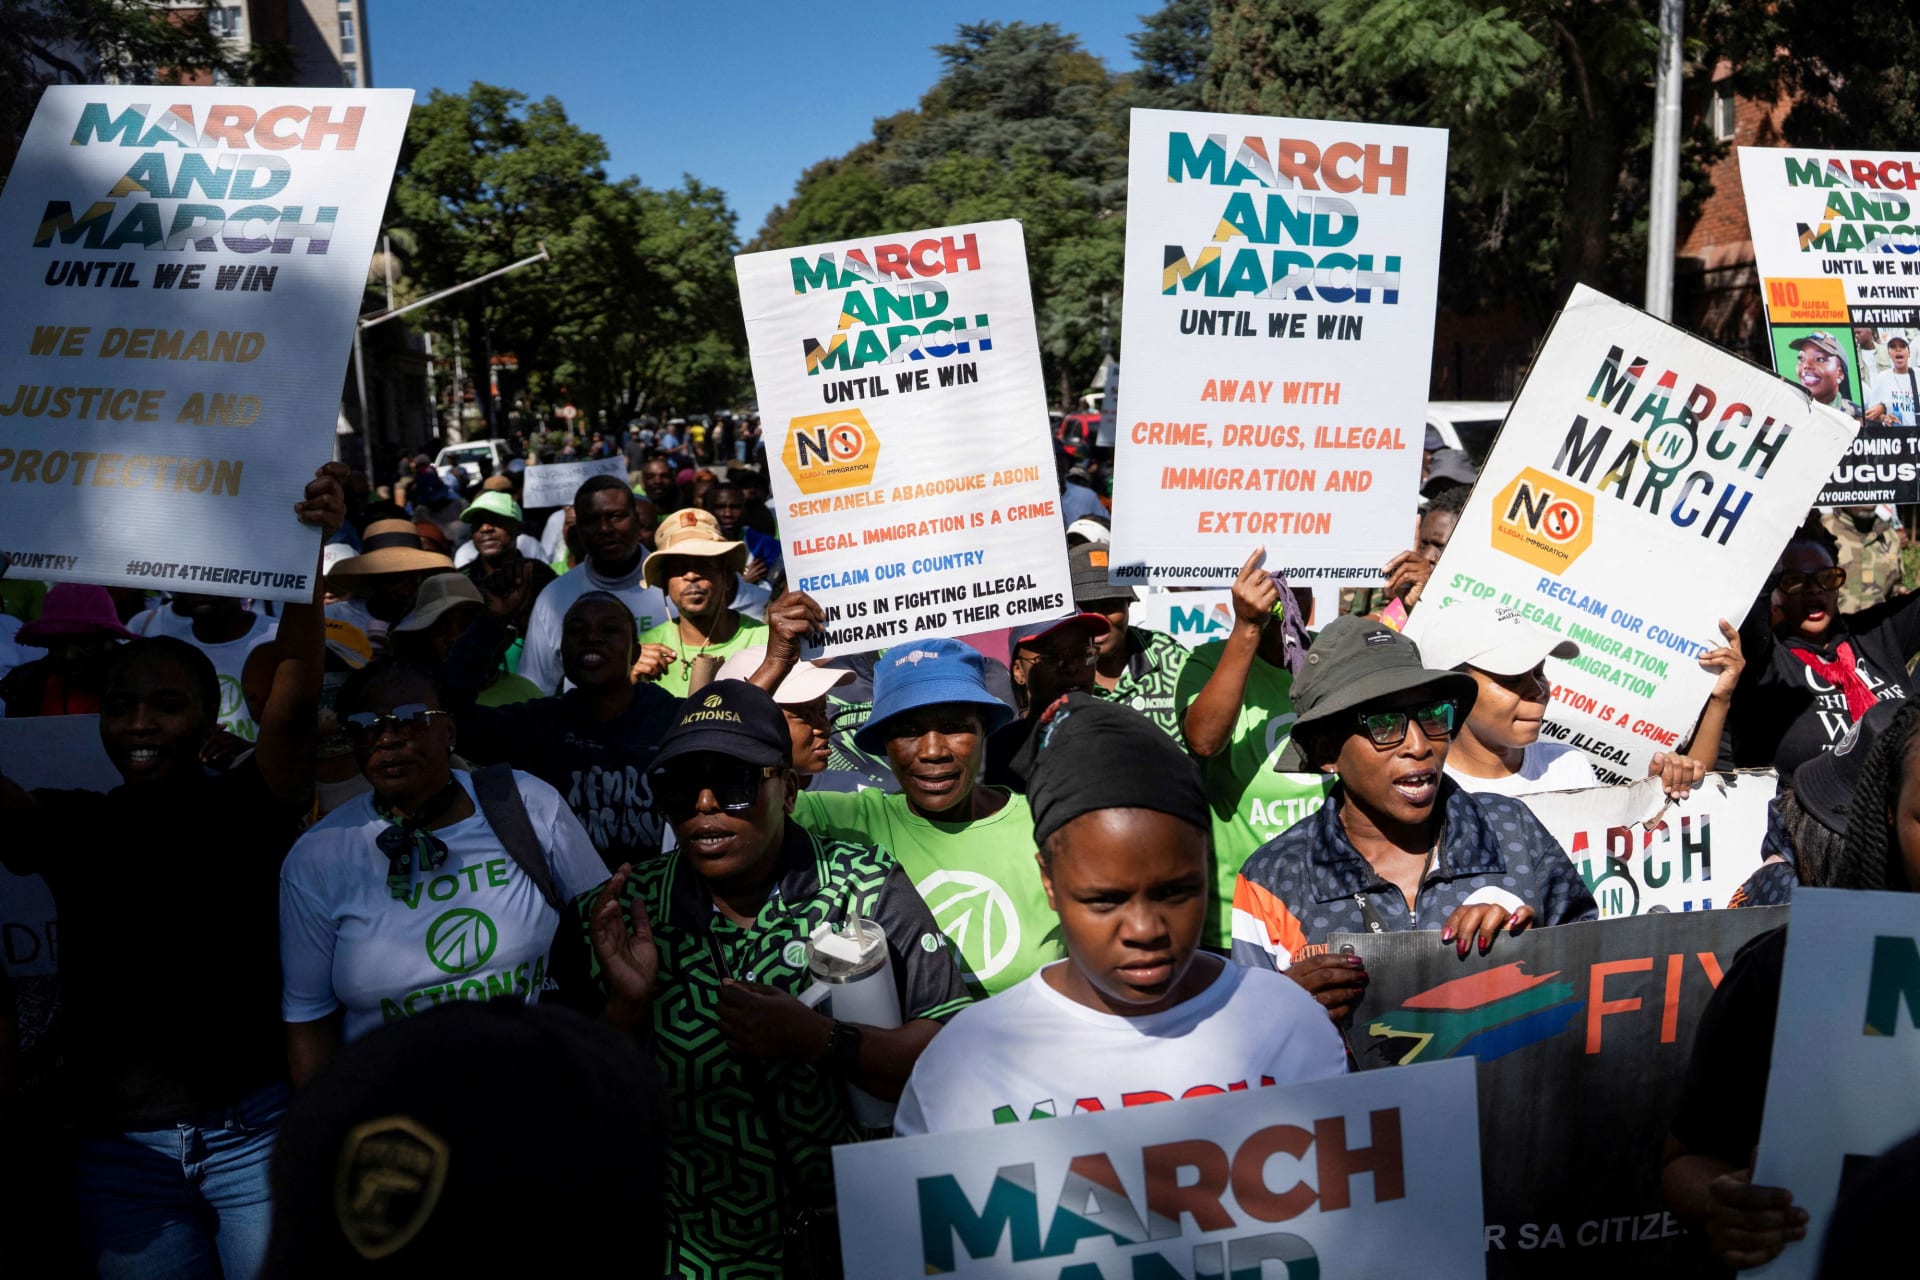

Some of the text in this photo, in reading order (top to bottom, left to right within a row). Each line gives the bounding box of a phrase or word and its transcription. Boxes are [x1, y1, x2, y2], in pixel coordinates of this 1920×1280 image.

[71, 102, 366, 151] MARCH
[107, 152, 291, 200] AND
[1168, 131, 1408, 196] MARCH
[33, 201, 339, 254] MARCH
[1211, 193, 1359, 247] AND
[1824, 191, 1910, 221] AND
[45, 261, 278, 292] UNTIL WE WIN
[790, 234, 981, 295] MARCH
[1162, 245, 1401, 304] MARCH
[1822, 259, 1868, 275] UNTIL
[1874, 260, 1896, 275] WE
[838, 281, 949, 330] AND
[1770, 281, 1800, 308] NO
[1790, 310, 1844, 321] IMMIGRATION
[1802, 300, 1830, 310] ILLEGAL
[29, 326, 266, 363] WE DEMAND
[803, 314, 993, 377] MARCH
[1180, 309, 1363, 341] UNTIL WE WIN
[823, 362, 979, 404] UNTIL WE WIN
[1201, 379, 1340, 404] AWAY WITH
[0, 385, 262, 427] JUSTICE AND
[1586, 344, 1793, 480] MARCH
[796, 422, 864, 468] NO
[1131, 422, 1406, 450] CRIME, DRUGS, ILLEGAL
[1658, 430, 1684, 458] IN
[827, 463, 869, 476] IMMIGRATION
[1161, 466, 1372, 492] IMMIGRATION AND
[1552, 415, 1753, 546] MARCH
[789, 466, 1039, 518] SEKWANELE ABAGODUKE ABONI
[1507, 483, 1580, 541] NO
[793, 501, 1055, 556] ILLEGAL IMMIGRATION IS A CRIME
[1197, 511, 1332, 535] EXTORTION
[1498, 525, 1569, 560] ILLEGAL IMMIGRATION
[125, 560, 307, 589] #DOIT4THEIRFUTURE
[799, 550, 984, 593] RECLAIM OUR COUNTRY
[1116, 566, 1243, 579] #DOIT4YOURCOUNTR
[847, 601, 868, 619] US
[873, 599, 889, 614] IN
[895, 585, 967, 612] FIGHTING
[973, 574, 1037, 598] ILLEGAL
[1536, 577, 1608, 619] RECLAIM
[1611, 609, 1643, 634] OUR
[808, 593, 1064, 649] IMMIGRANTS AND THEIR CRIMES
[1450, 573, 1496, 600] STOP
[1566, 622, 1669, 680] IMMIGRATION,
[680, 711, 742, 727] ACTIONSA
[1597, 704, 1615, 721] IS
[1616, 713, 1630, 729] A
[1632, 719, 1679, 748] CRIME
[1570, 732, 1631, 767] ILLEGAL
[1571, 814, 1711, 890] ARCH
[402, 858, 510, 909] VOTE
[1601, 887, 1624, 916] IN
[917, 1106, 1405, 1276] MARCH
[1518, 1223, 1567, 1250] SA
[1576, 1210, 1688, 1248] CITIZE
